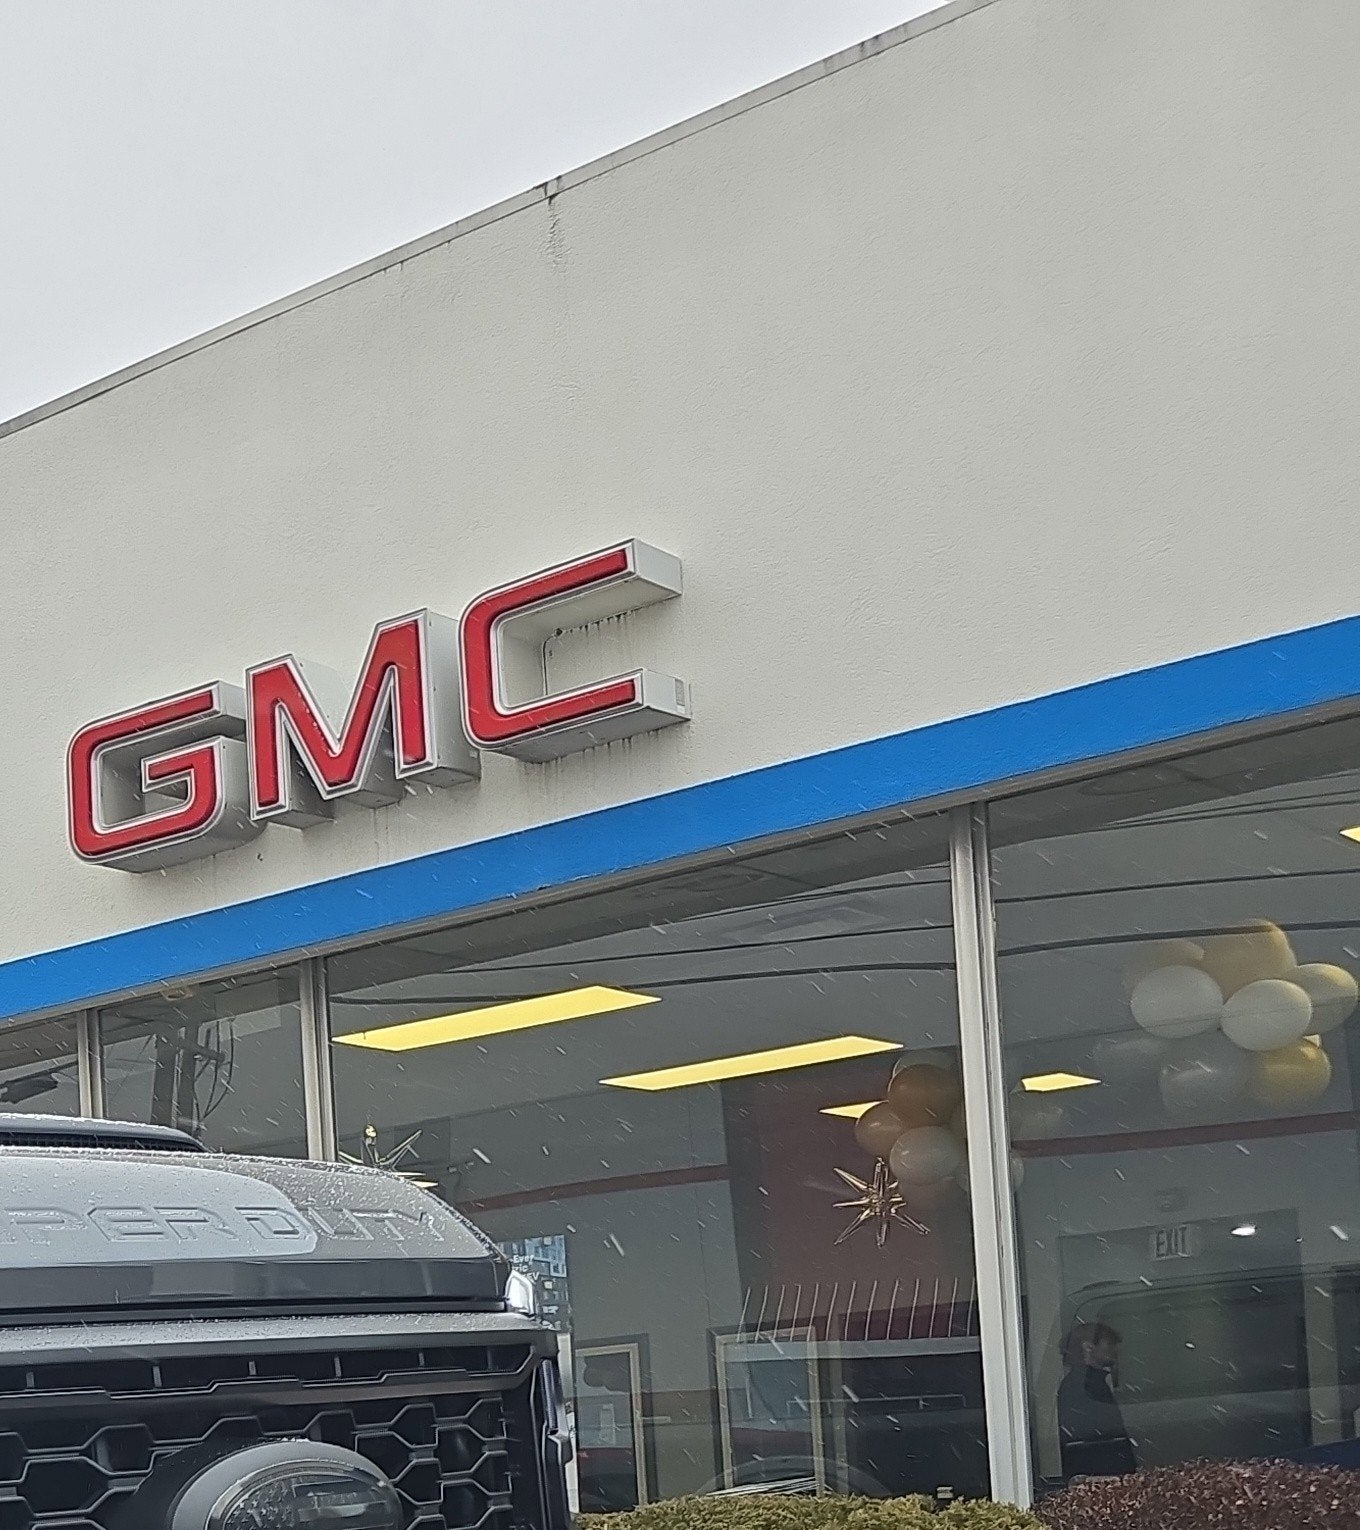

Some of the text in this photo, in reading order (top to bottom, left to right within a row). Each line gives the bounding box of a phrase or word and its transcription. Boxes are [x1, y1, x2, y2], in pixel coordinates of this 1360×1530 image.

[67, 538, 652, 866] GMC
[234, 1204, 445, 1243] DUTY
[1155, 1226, 1188, 1257] EXIT
